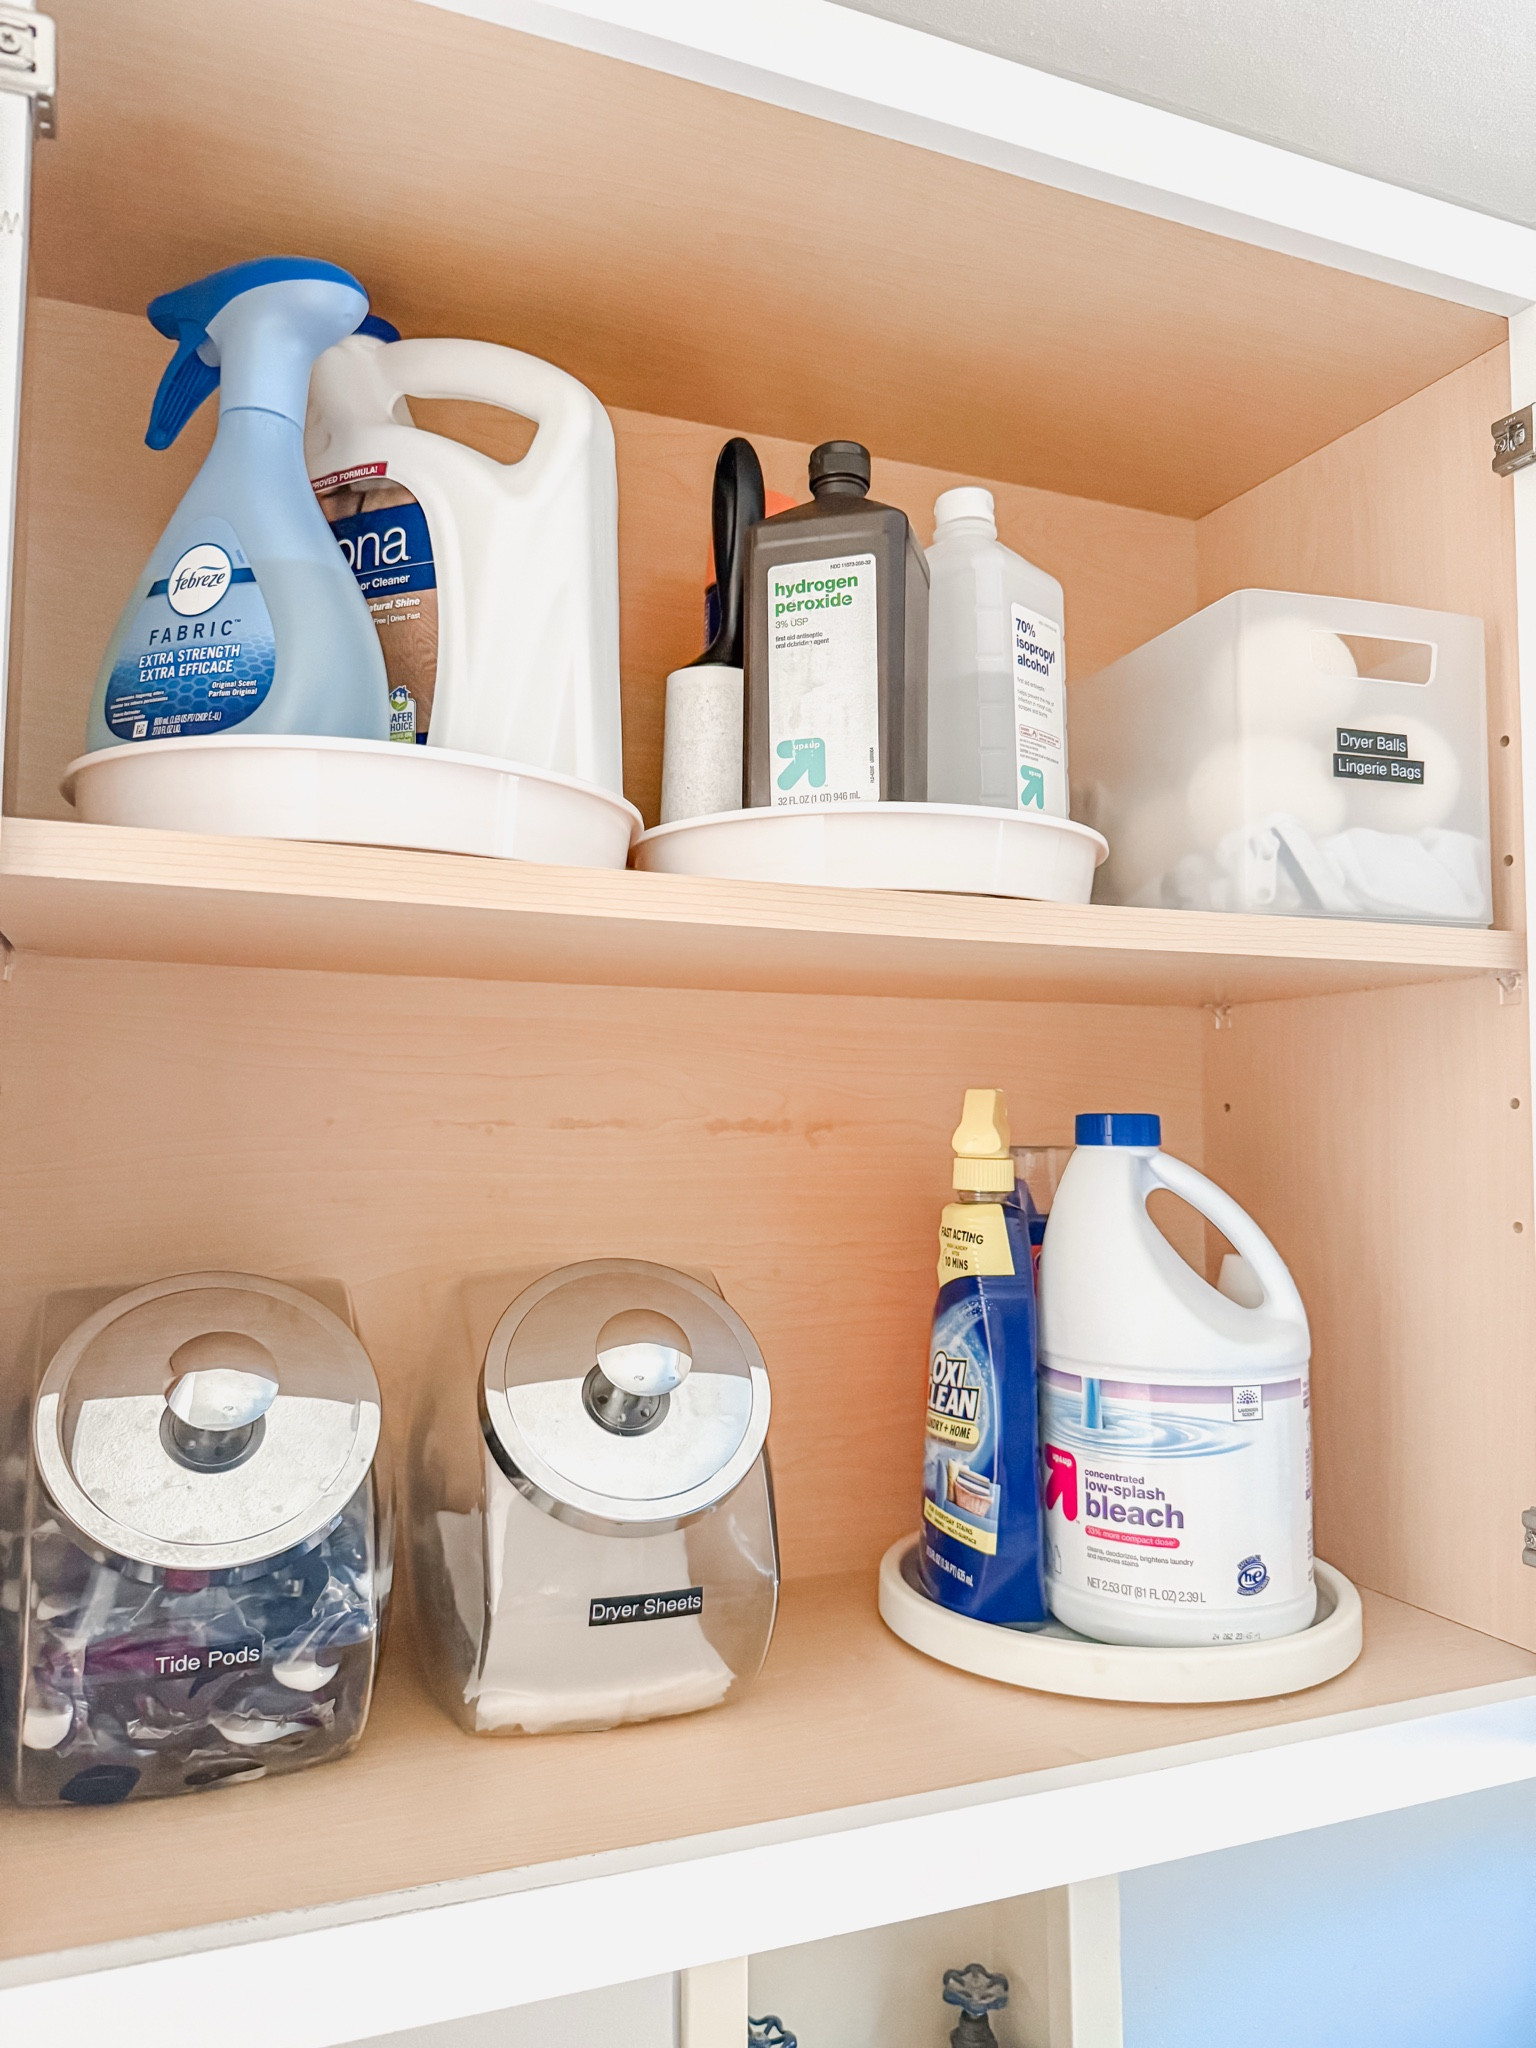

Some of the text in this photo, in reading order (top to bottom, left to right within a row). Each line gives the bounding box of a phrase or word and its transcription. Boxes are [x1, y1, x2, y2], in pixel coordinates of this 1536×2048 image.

[313, 466, 378, 489] ROVED FORMULA!
[172, 566, 226, 595] febreze
[372, 575, 411, 588] Cleaner
[775, 576, 858, 598] hydrogen
[369, 597, 421, 612] atural Shine
[775, 593, 853, 617] peroxide
[775, 617, 809, 629] 3% USP
[1015, 617, 1036, 638] 70%
[796, 631, 823, 639] antiseptic
[813, 637, 830, 646] agent
[138, 644, 241, 669] EXTRA STRENGTH
[1016, 634, 1056, 664] isopropyl
[139, 660, 234, 682] EXTRA EFFICACE
[1017, 653, 1049, 676] alcohol
[208, 688, 258, 698] Parfum Original
[212, 681, 237, 690] Original
[391, 711, 413, 723] AFER
[390, 721, 413, 732] HOICE
[793, 742, 820, 750] up&up
[1340, 732, 1406, 753] Dryer Balls
[1337, 758, 1421, 780] Lingerie Bags
[778, 790, 861, 806] 32 FL OZ (1 QT) 946 mL
[941, 1226, 984, 1245] FAST ACTING
[945, 1256, 969, 1270] 10 MINS
[932, 1351, 967, 1388] OXI
[929, 1384, 979, 1420] LEAN
[950, 1424, 971, 1439] HOME
[1052, 1453, 1073, 1468] up&up
[1085, 1469, 1145, 1485] concentrated
[1085, 1477, 1166, 1501] low-splash
[1086, 1492, 1185, 1529] bleach
[1102, 1531, 1120, 1541] more
[1121, 1533, 1154, 1546] compact
[1087, 1552, 1139, 1567] and removes stains
[1106, 1549, 1139, 1561] deodorizes,
[1140, 1555, 1169, 1565] brightens
[1170, 1558, 1194, 1567] laundry
[1243, 1569, 1262, 1584] he
[1087, 1576, 1207, 1603] NET 2.53 QT (81 FL OZ) 2.39 L
[591, 1595, 702, 1620] Dryer Sheets
[155, 1646, 260, 1674] Tide Pods
